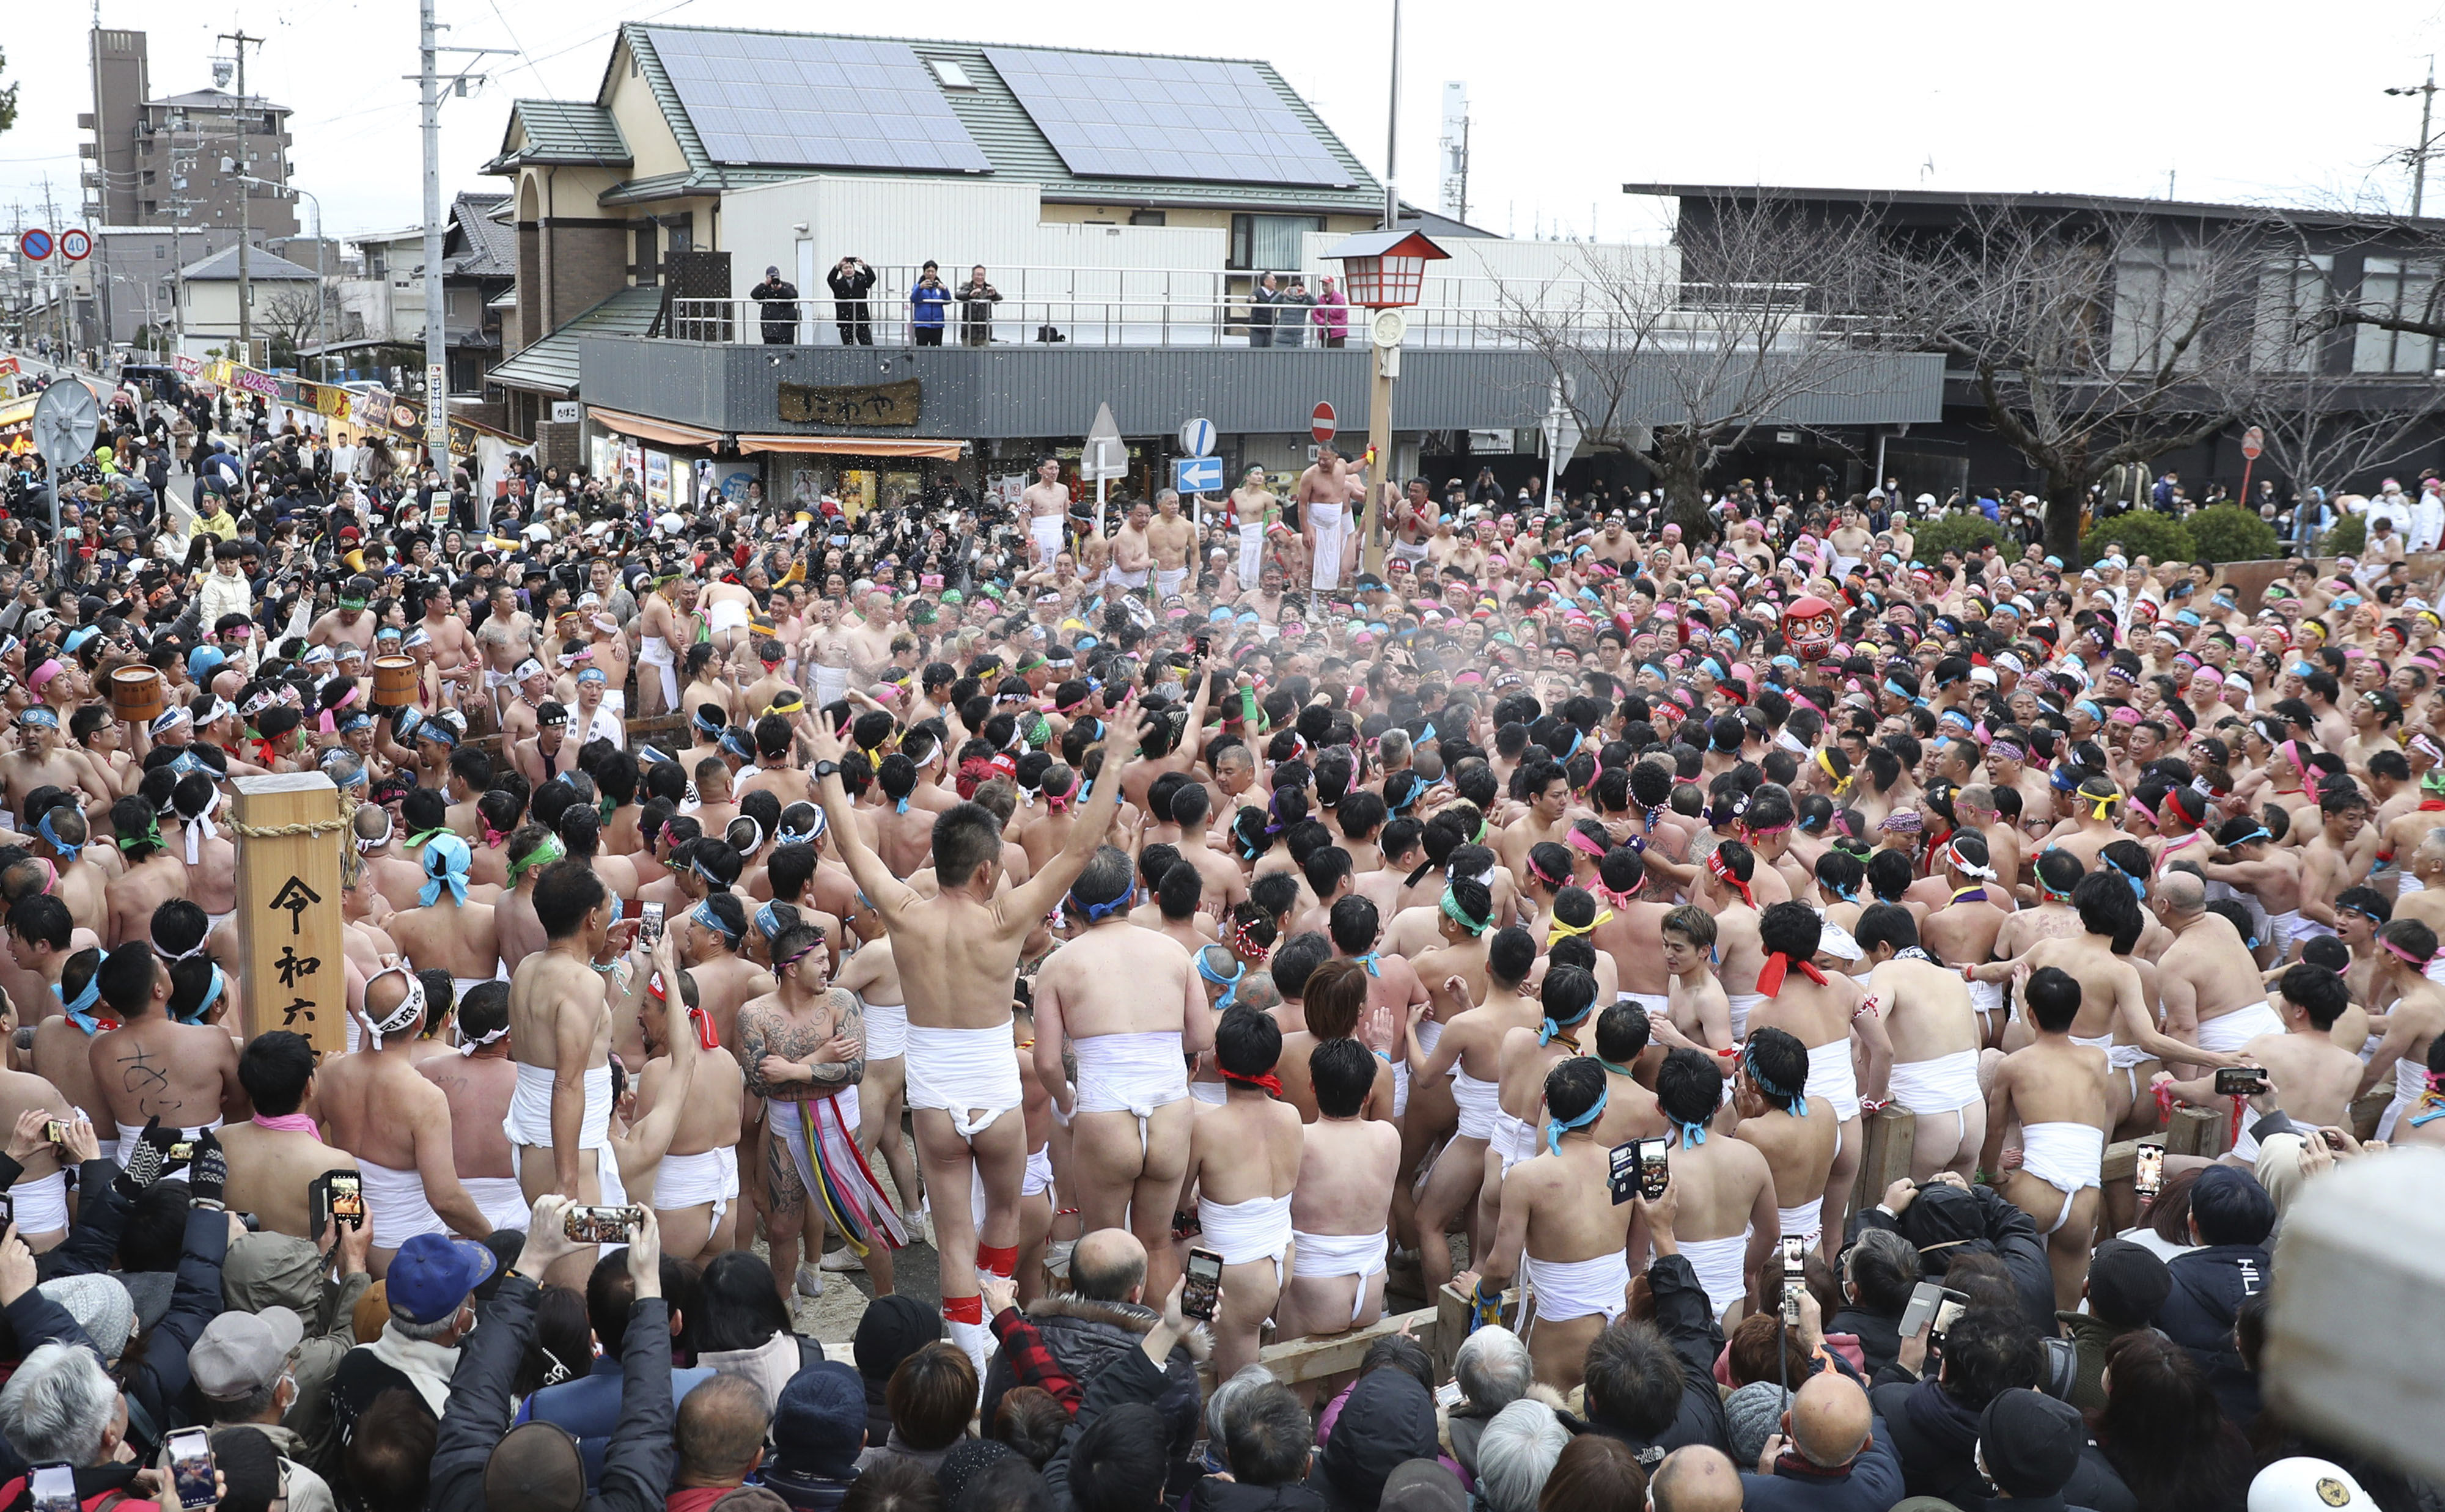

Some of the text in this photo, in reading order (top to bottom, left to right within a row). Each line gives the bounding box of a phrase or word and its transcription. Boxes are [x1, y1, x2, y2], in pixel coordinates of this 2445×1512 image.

[68, 238, 85, 252] 40
[557, 408, 576, 417] たばこ
[270, 875, 322, 1055] 令和六
[2237, 1258, 2260, 1296] HIL
[1641, 1446, 1655, 1455] THE
[1633, 1451, 1656, 1461] NORTH
[1640, 1456, 1655, 1465] FACE
